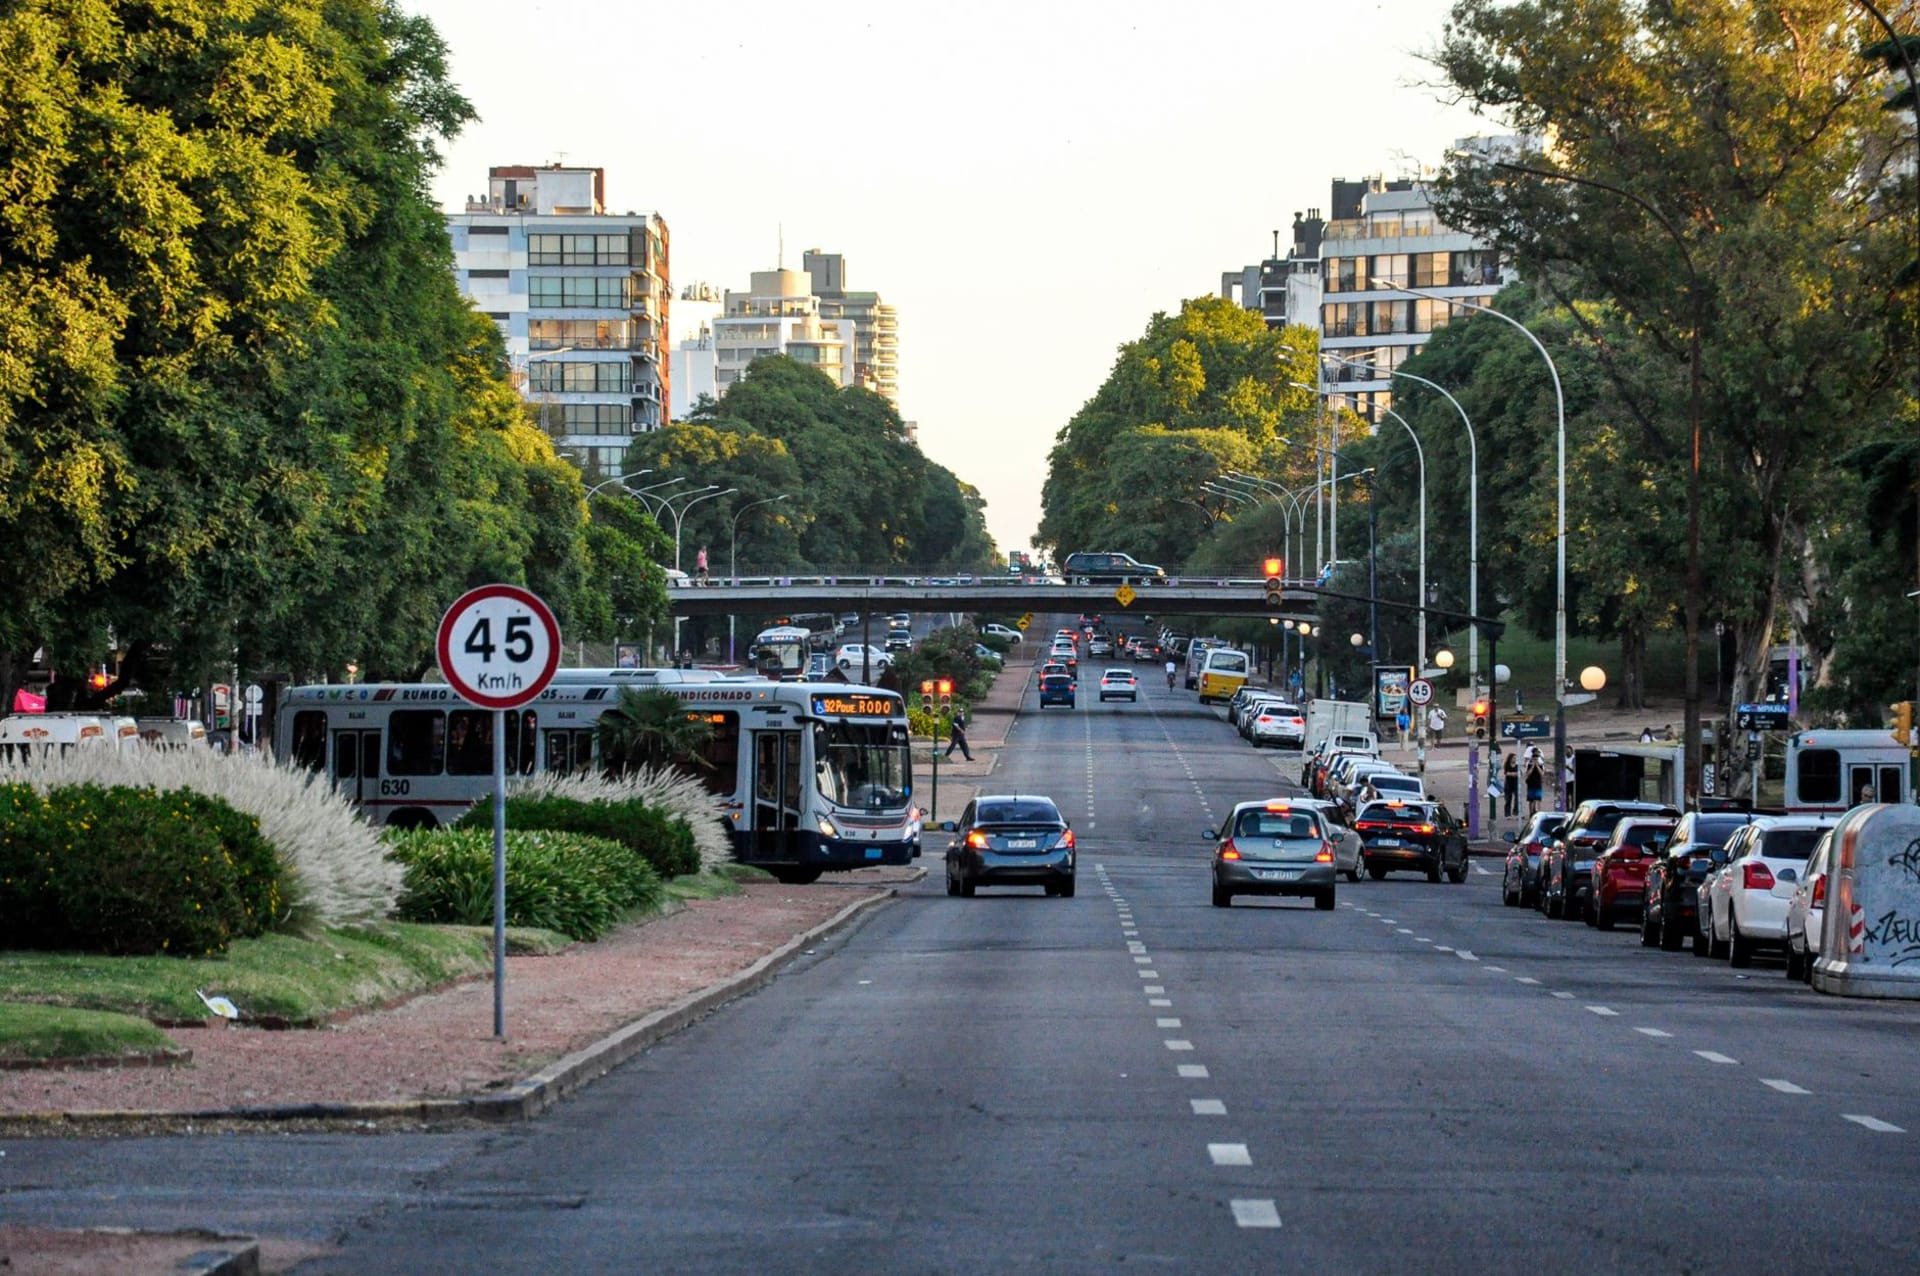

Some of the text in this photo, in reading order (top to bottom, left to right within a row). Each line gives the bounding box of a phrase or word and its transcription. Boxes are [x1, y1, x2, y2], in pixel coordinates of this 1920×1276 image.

[464, 616, 534, 664] 45
[478, 673, 522, 691] Km/h
[402, 689, 447, 699] RUMBO
[1412, 685, 1428, 696] 45
[823, 698, 836, 713] 92
[859, 700, 891, 714] RODO
[381, 779, 410, 795] 630
